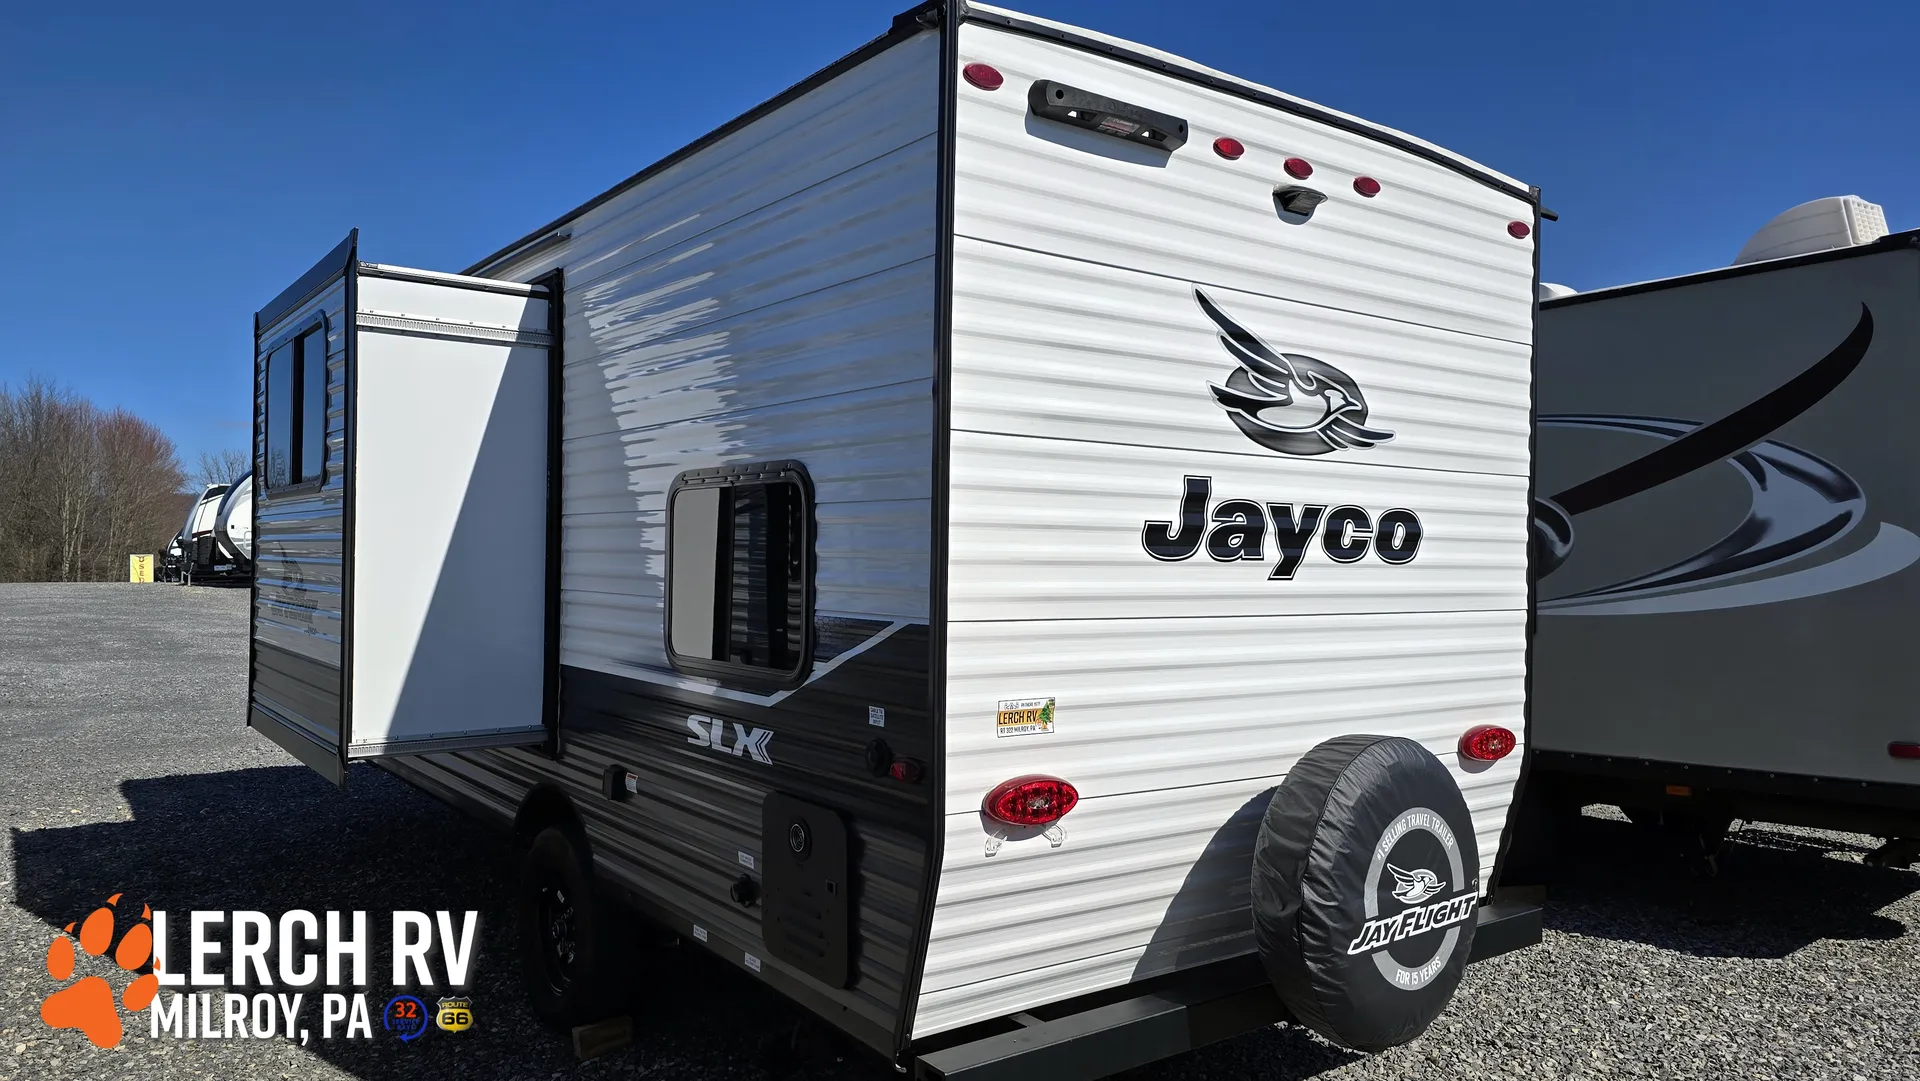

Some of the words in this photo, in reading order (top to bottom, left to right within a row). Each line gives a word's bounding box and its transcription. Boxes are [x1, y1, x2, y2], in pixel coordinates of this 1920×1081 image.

[1141, 475, 1424, 580] Jayco
[687, 714, 774, 765] SLX
[999, 711, 1025, 725] LERCH
[1027, 710, 1038, 722] RV
[1376, 849, 1385, 861] #1
[1383, 820, 1407, 851] SELLING
[1407, 813, 1430, 828] TRAVEL
[1431, 817, 1454, 850] TRAILER
[1395, 968, 1410, 983] FOR
[1411, 971, 1419, 985] 15
[1419, 956, 1442, 982] YEARS
